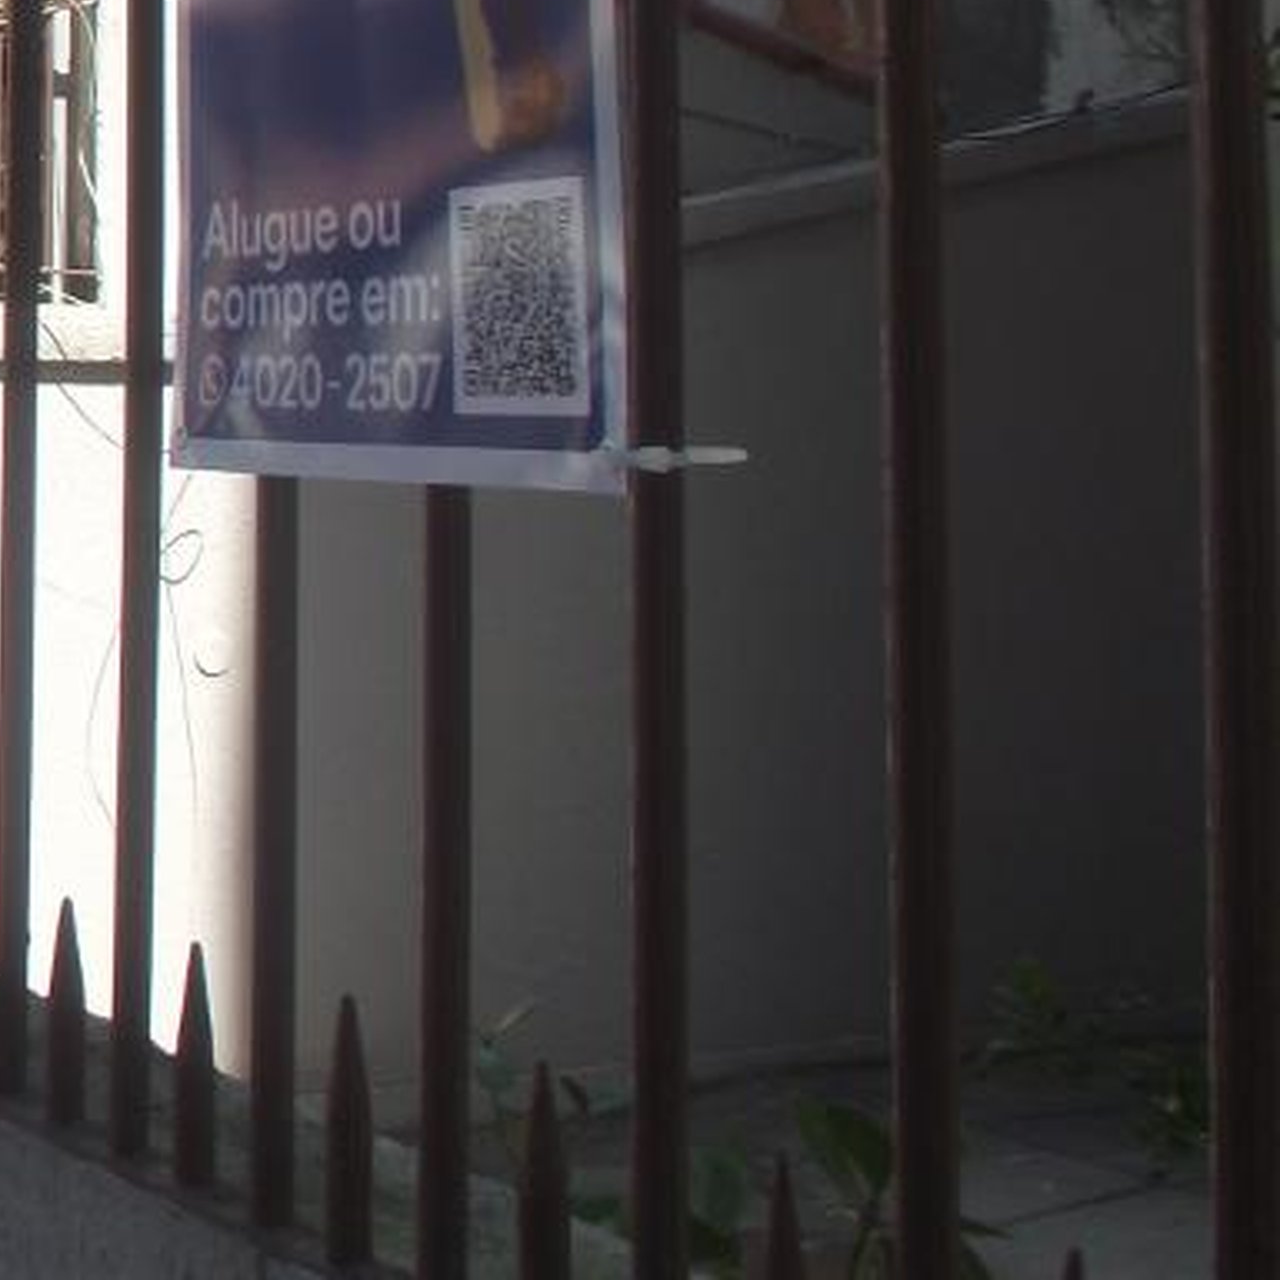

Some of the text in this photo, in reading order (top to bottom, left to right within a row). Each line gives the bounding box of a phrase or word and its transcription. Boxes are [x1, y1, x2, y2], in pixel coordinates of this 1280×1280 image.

[202, 199, 402, 271] Alugue ou
[201, 273, 441, 343] compre em:
[229, 352, 442, 412] 4020-2507
